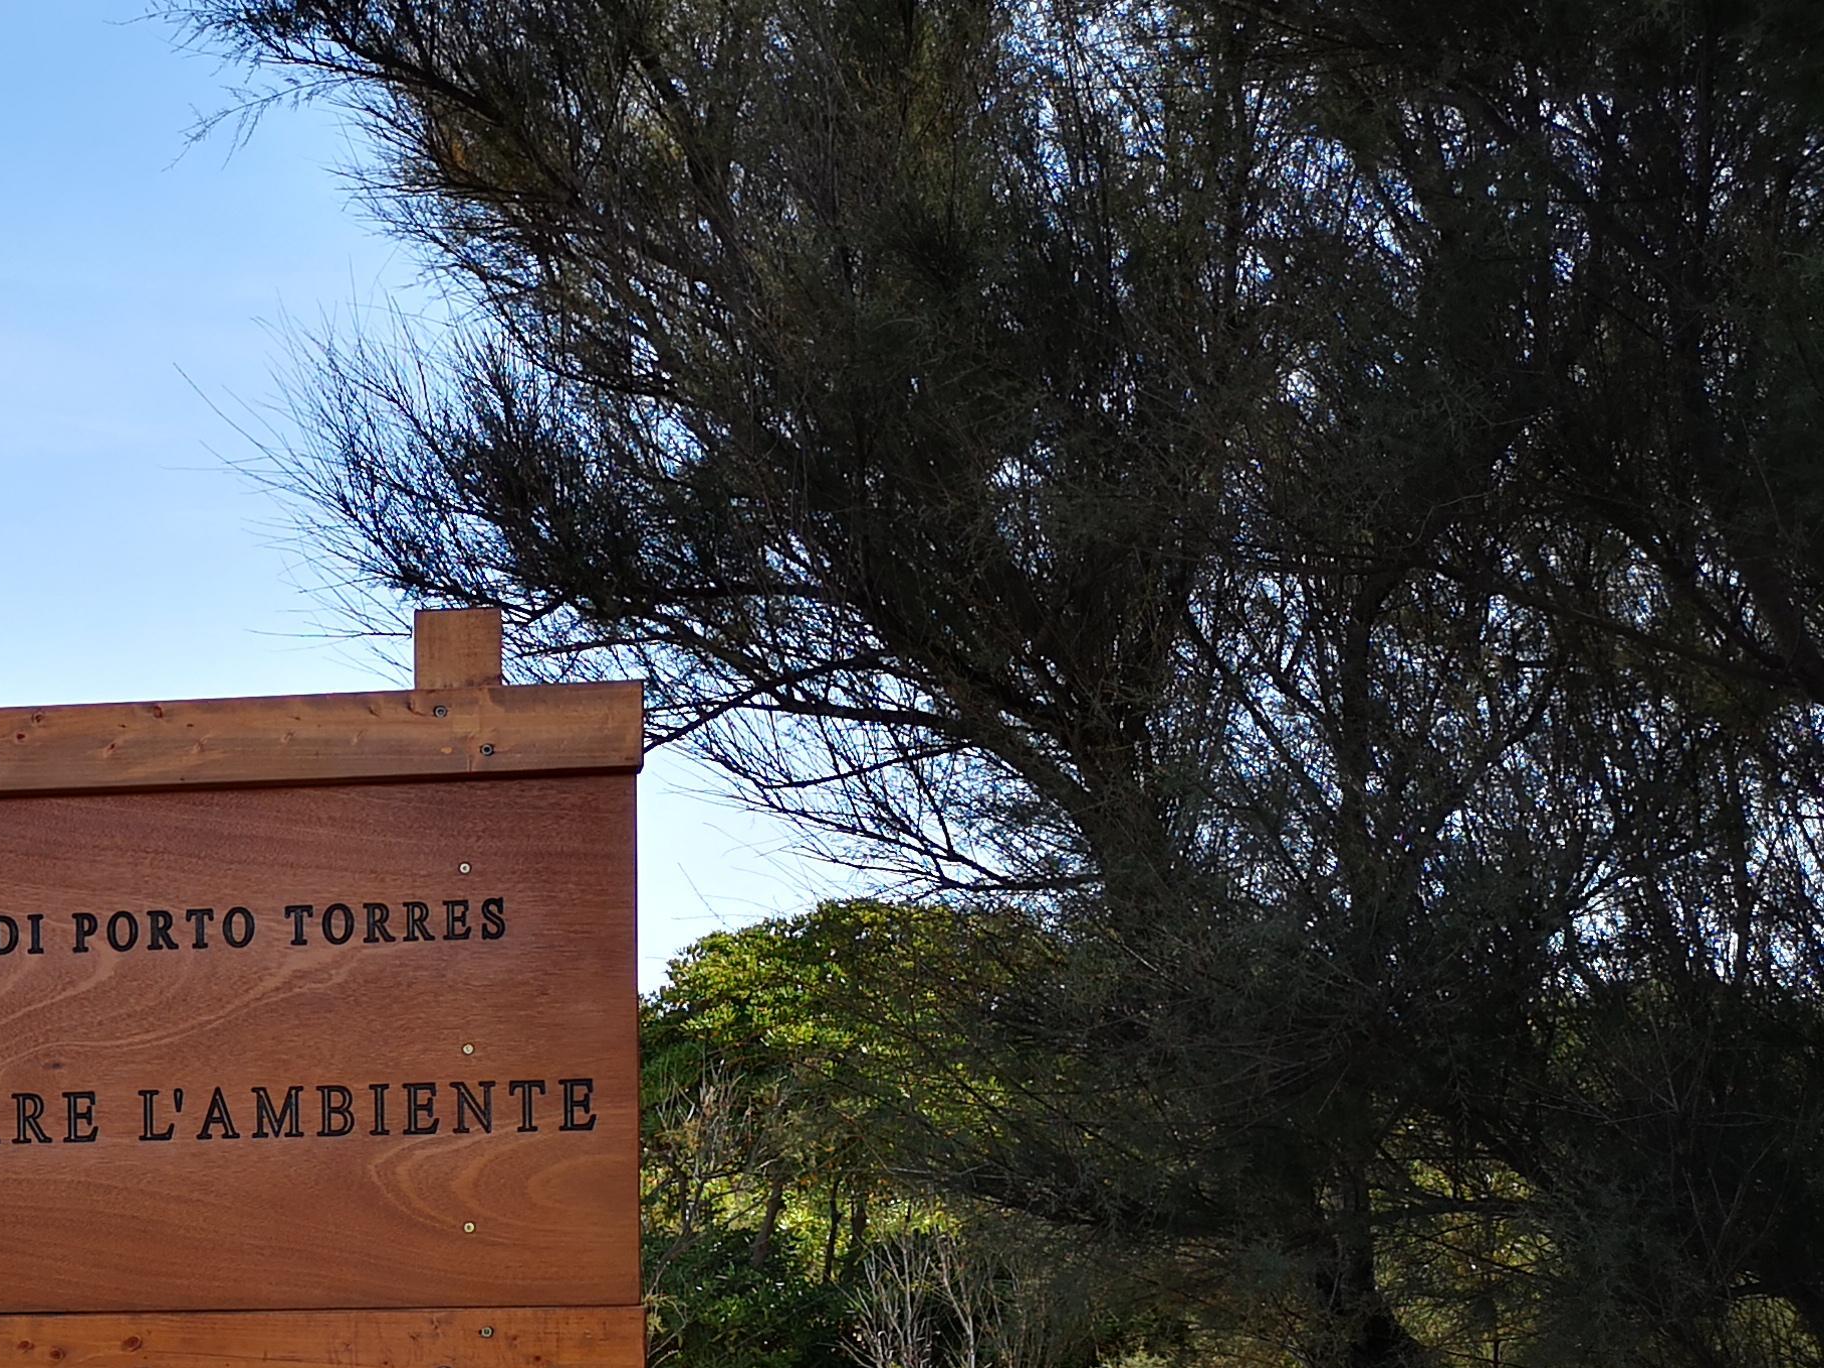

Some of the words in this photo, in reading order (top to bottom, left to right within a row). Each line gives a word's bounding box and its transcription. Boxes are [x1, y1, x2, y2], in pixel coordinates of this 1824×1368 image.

[71, 906, 256, 954] PORTO
[284, 896, 507, 946] TORRES
[137, 1077, 597, 1142] L'AMBIENTE
